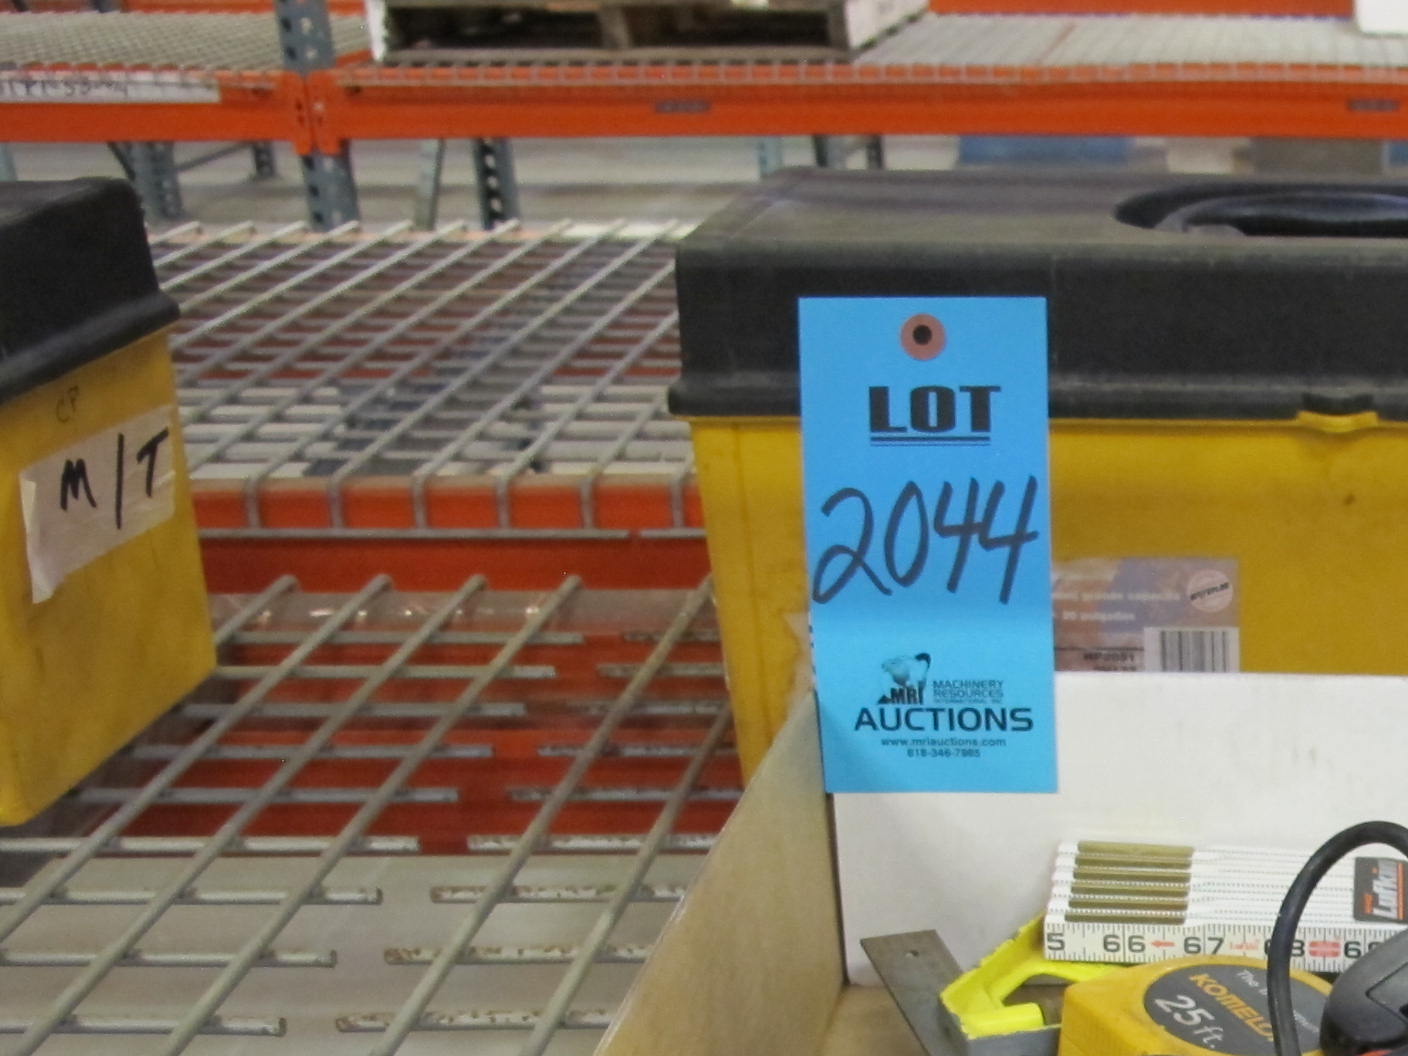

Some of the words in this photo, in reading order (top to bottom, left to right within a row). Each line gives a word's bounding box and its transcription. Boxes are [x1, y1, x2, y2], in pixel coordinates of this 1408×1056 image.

[868, 386, 1001, 433] LOT
[812, 475, 1039, 605] 2044
[933, 680, 1004, 689] MACHINERY
[934, 689, 1004, 698] RESOURCES
[853, 706, 1034, 731] AUCTIONS
[1102, 934, 1146, 953] 66
[1183, 936, 1225, 955] 67
